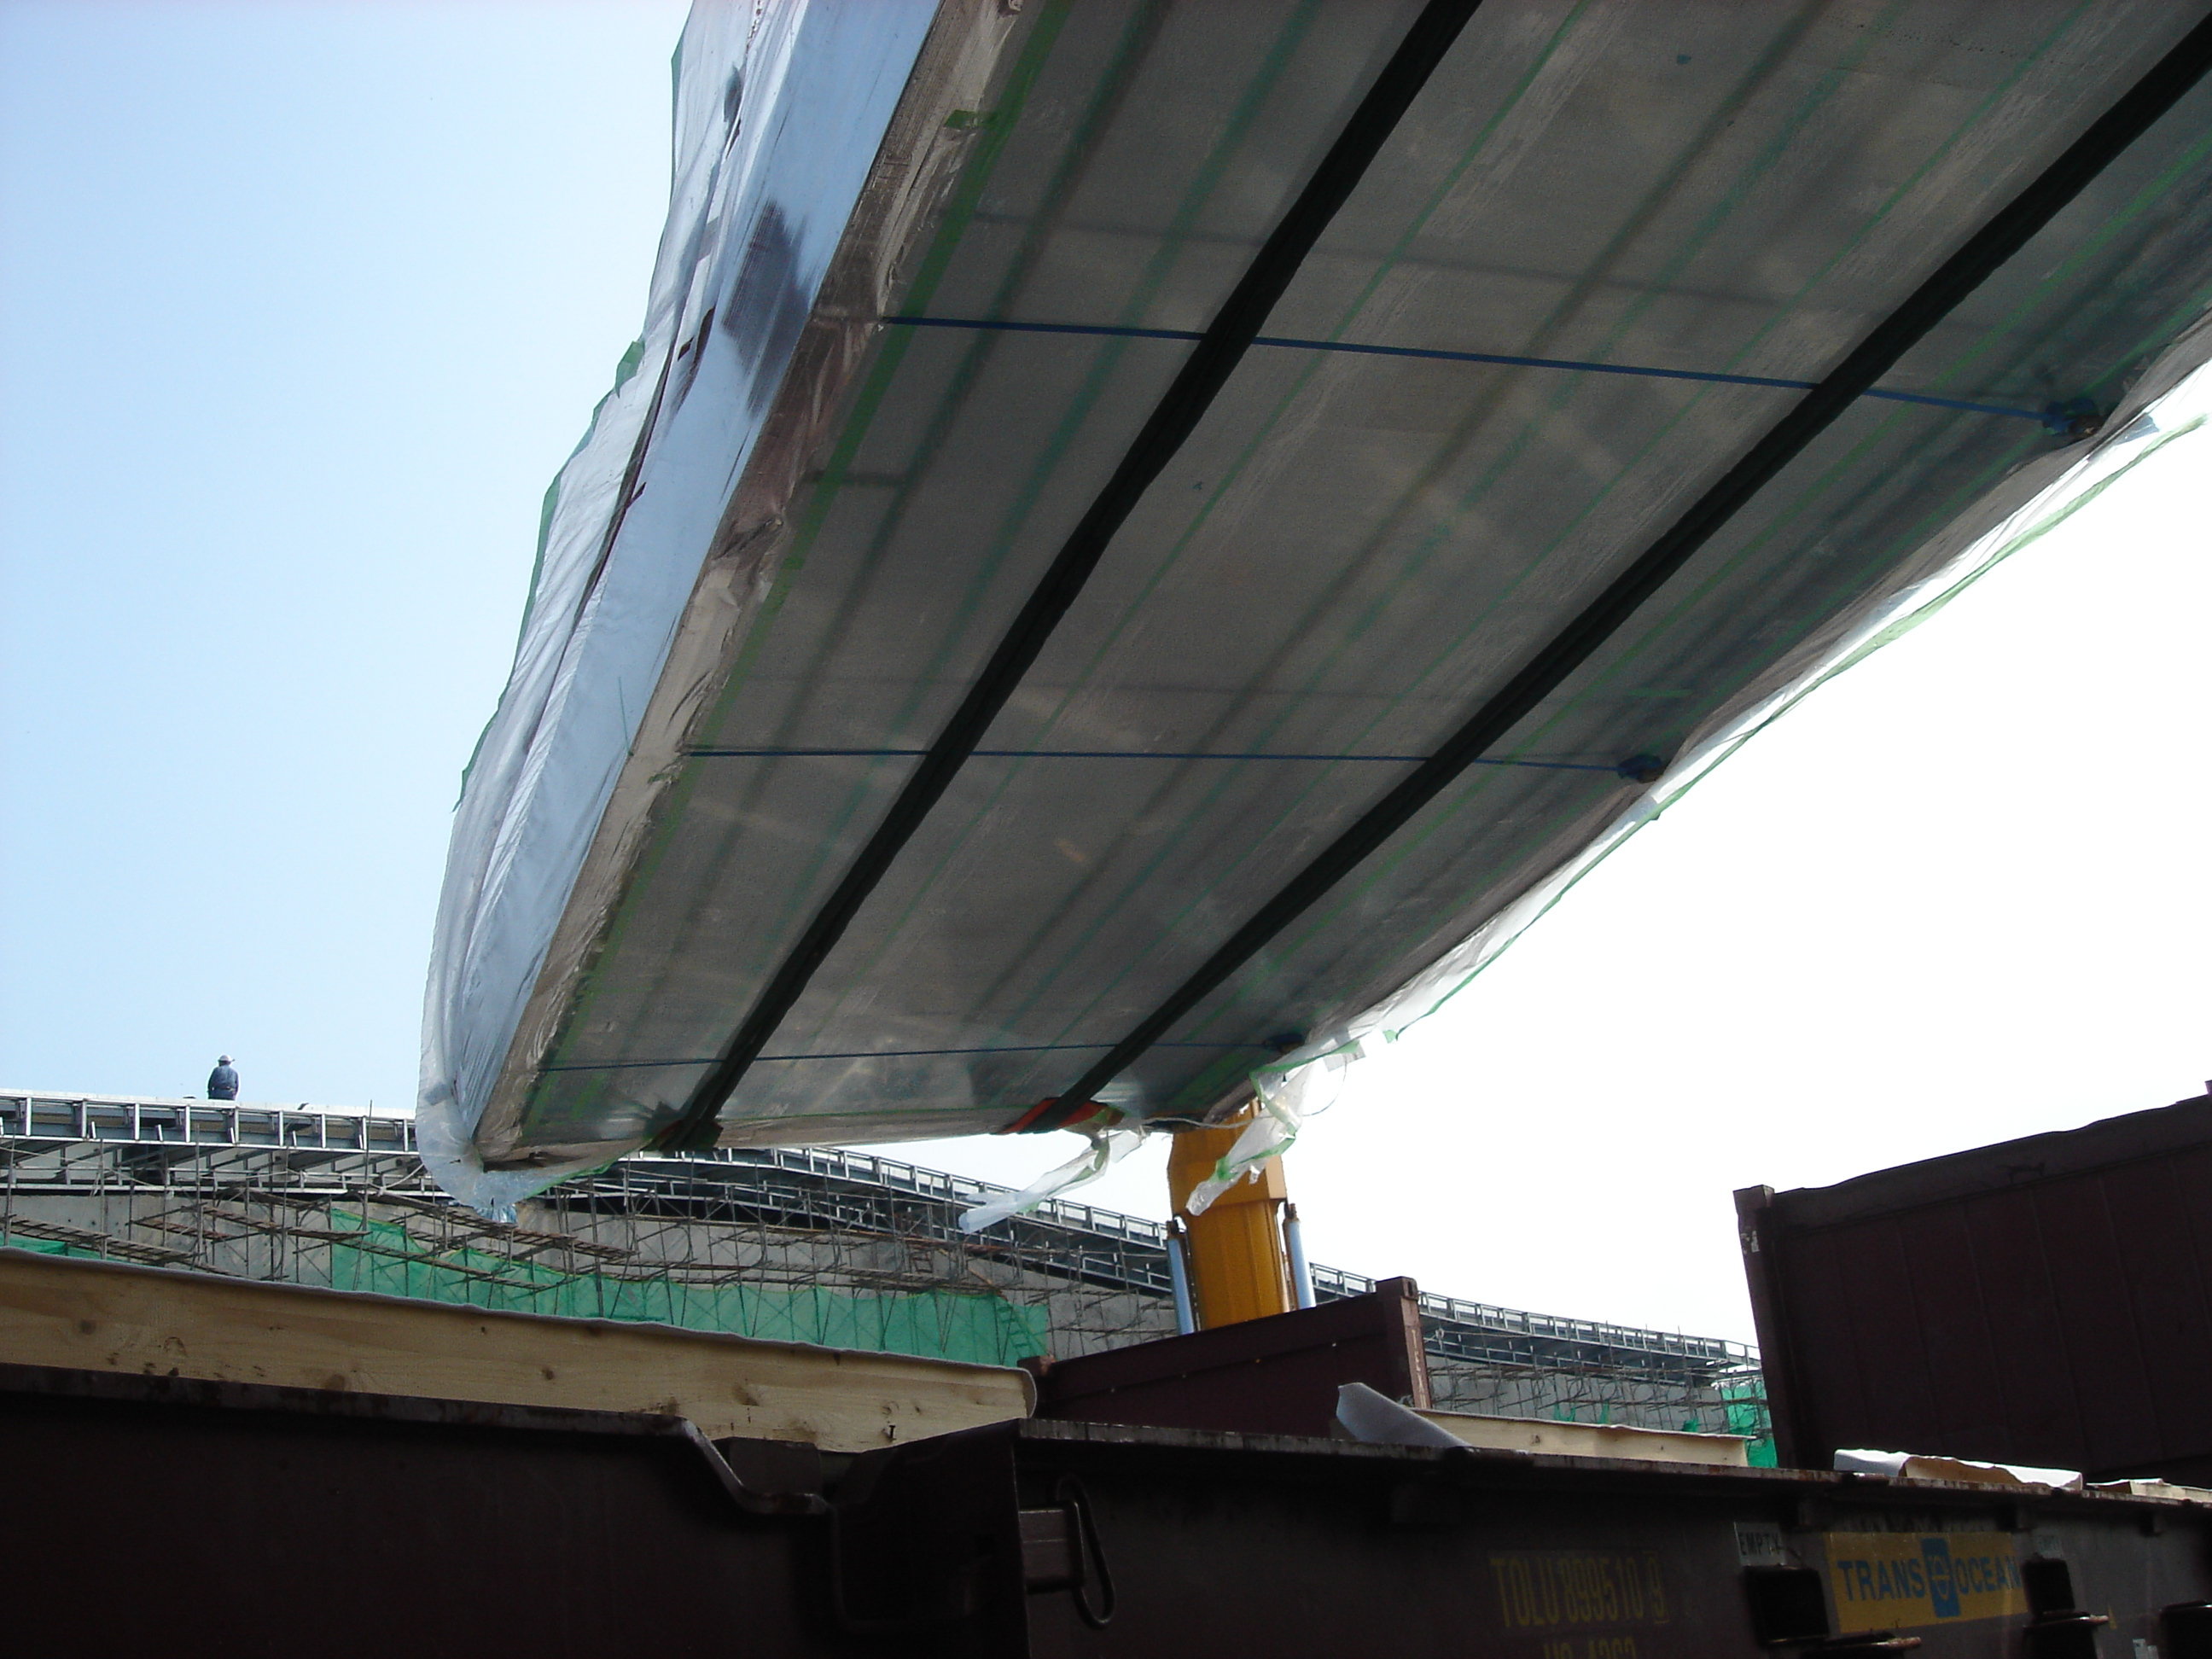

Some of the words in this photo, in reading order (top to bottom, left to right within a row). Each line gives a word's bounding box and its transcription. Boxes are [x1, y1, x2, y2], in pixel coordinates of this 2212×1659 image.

[1489, 1557, 1560, 1627] TOLU
[1837, 1558, 1925, 1601] TRANS
[1954, 1556, 2022, 1595] OCEAN
